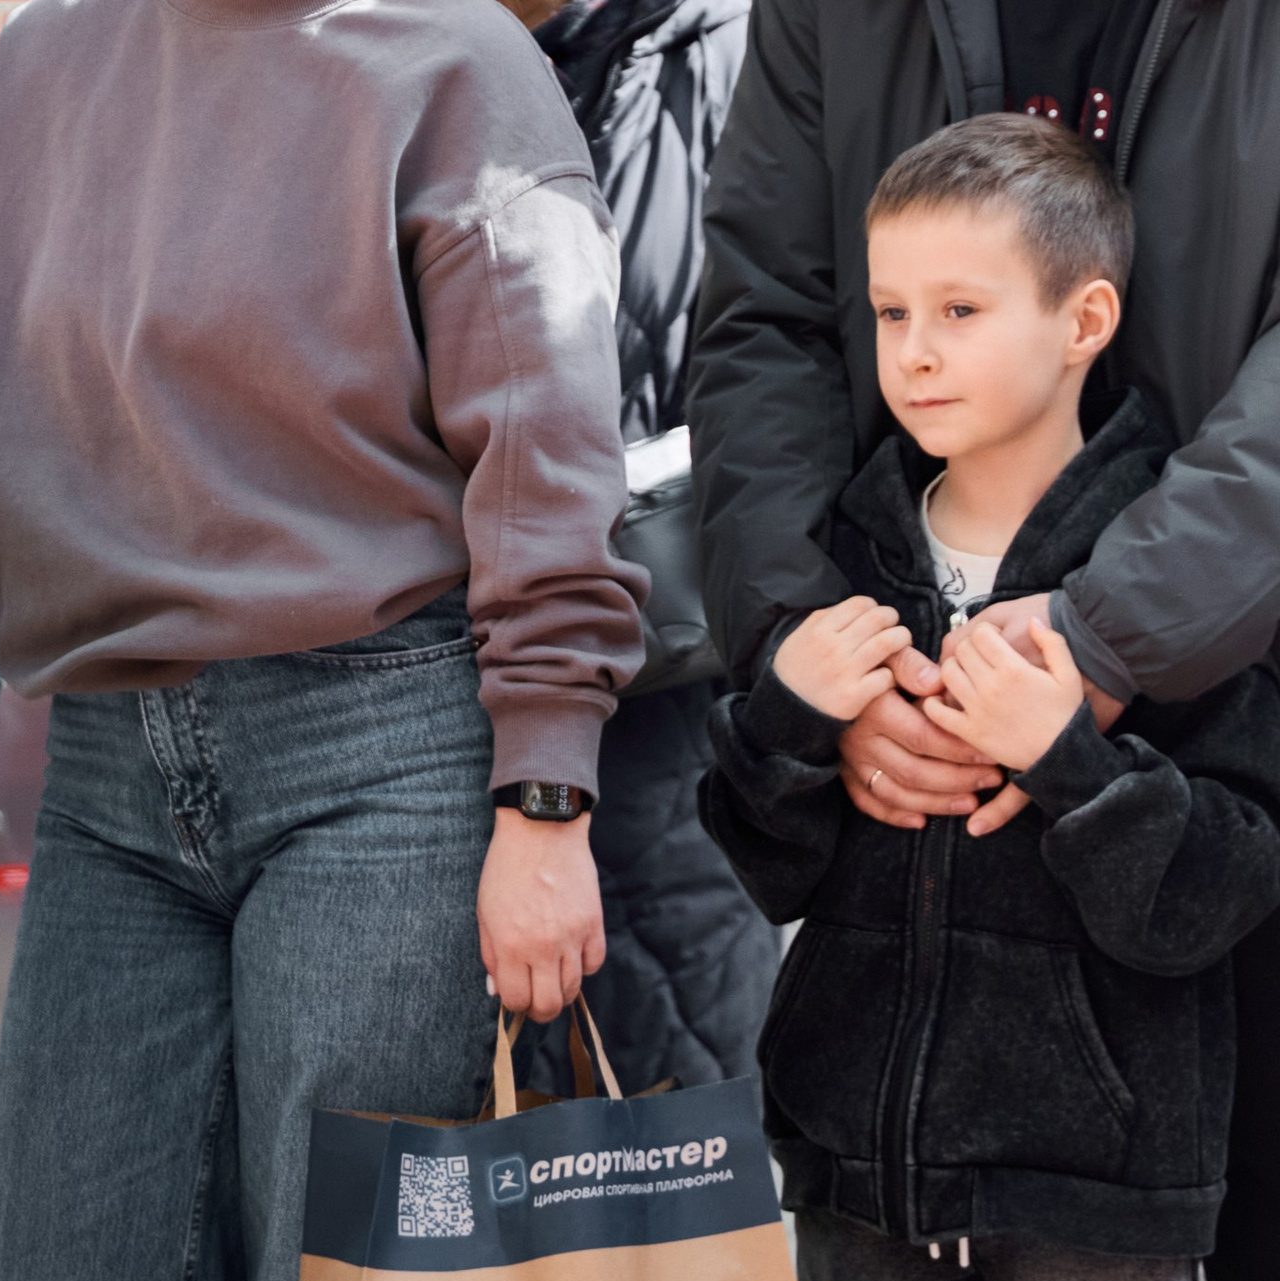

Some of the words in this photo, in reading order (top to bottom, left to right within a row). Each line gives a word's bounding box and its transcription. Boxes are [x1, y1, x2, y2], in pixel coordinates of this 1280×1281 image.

[533, 1185, 604, 1208] ЦИФРОВАЯ
[606, 1181, 654, 1196] СПОРТИВНАЯ
[656, 1169, 734, 1193] ПЛАТФОРМА
